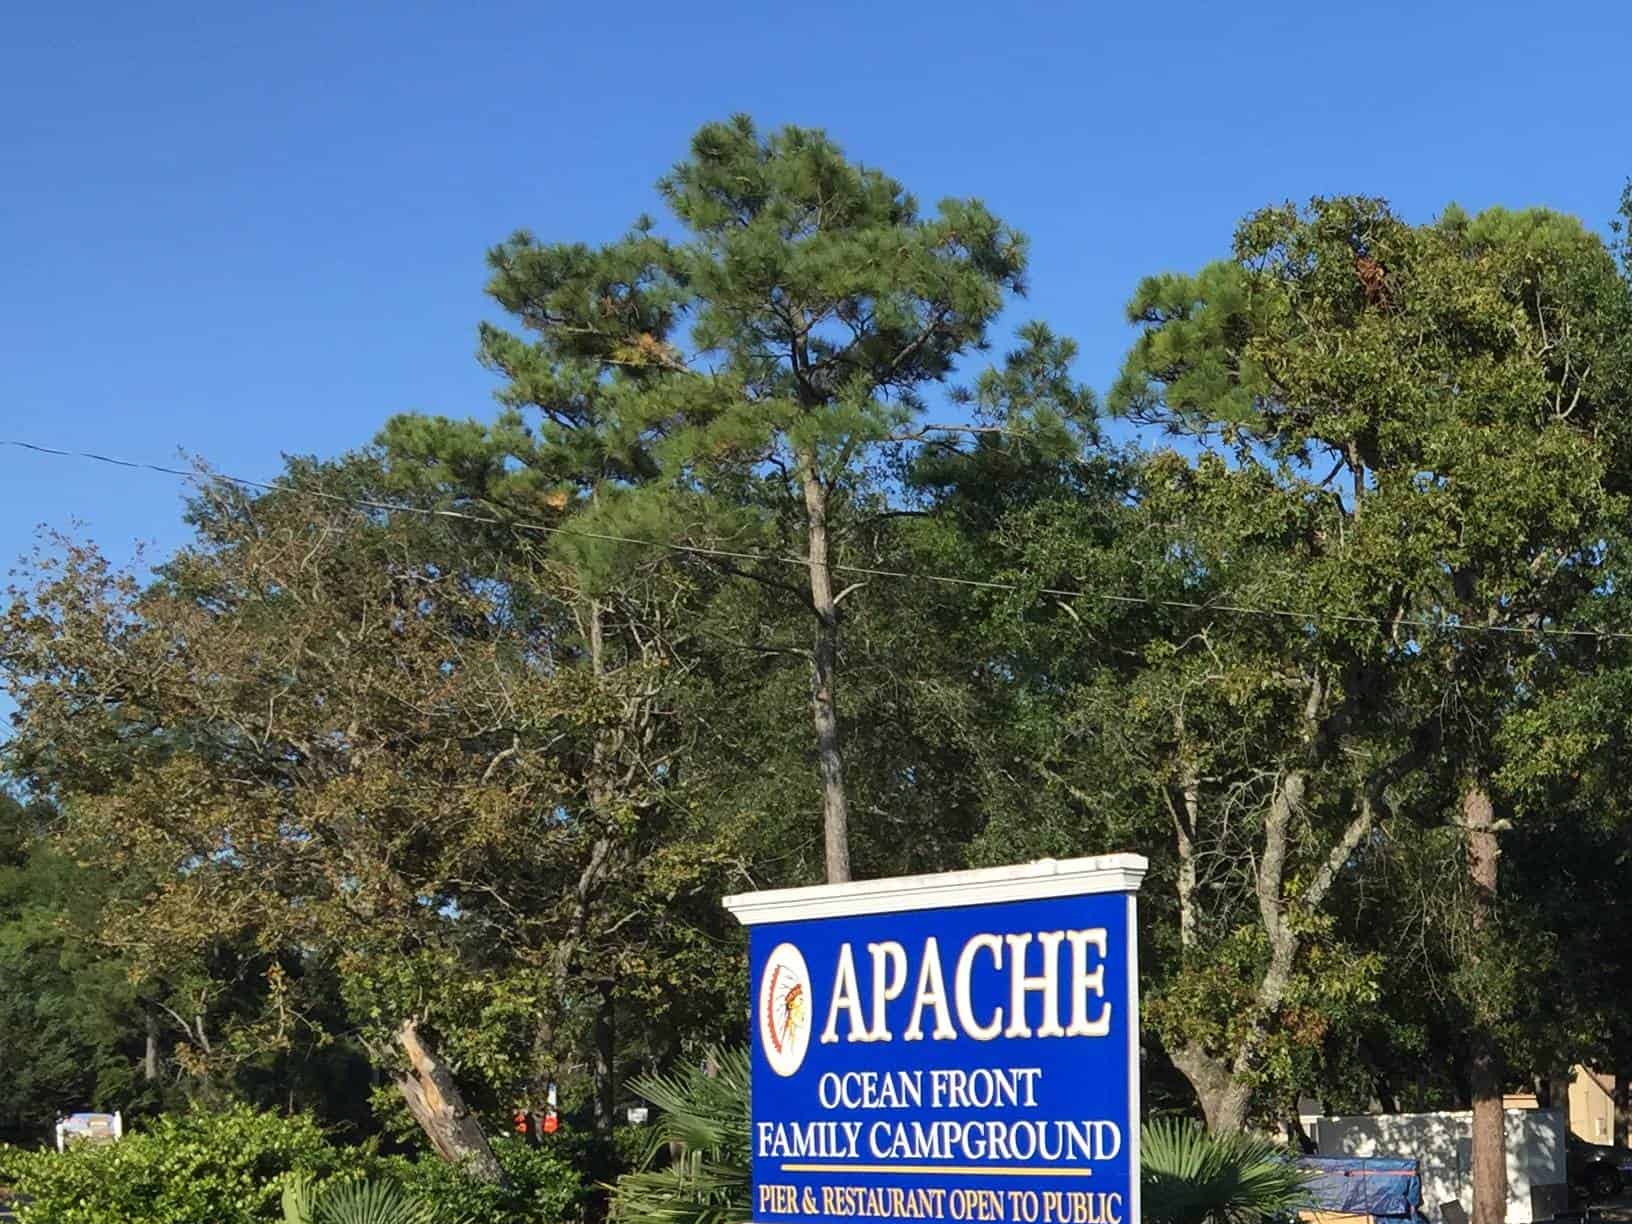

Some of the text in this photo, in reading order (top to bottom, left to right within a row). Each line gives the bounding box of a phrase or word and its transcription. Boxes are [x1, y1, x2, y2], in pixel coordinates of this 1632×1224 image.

[820, 927, 1112, 1044] APACHE
[818, 1068, 1042, 1109] OCEAN FRONT
[757, 1120, 1121, 1160] FAMILY CAMPGROUND
[759, 1184, 799, 1214] PIER
[802, 1186, 819, 1215] &
[821, 1186, 946, 1219] RESTAURANT
[950, 1189, 1004, 1221] OPEN
[1008, 1190, 1039, 1223] TO
